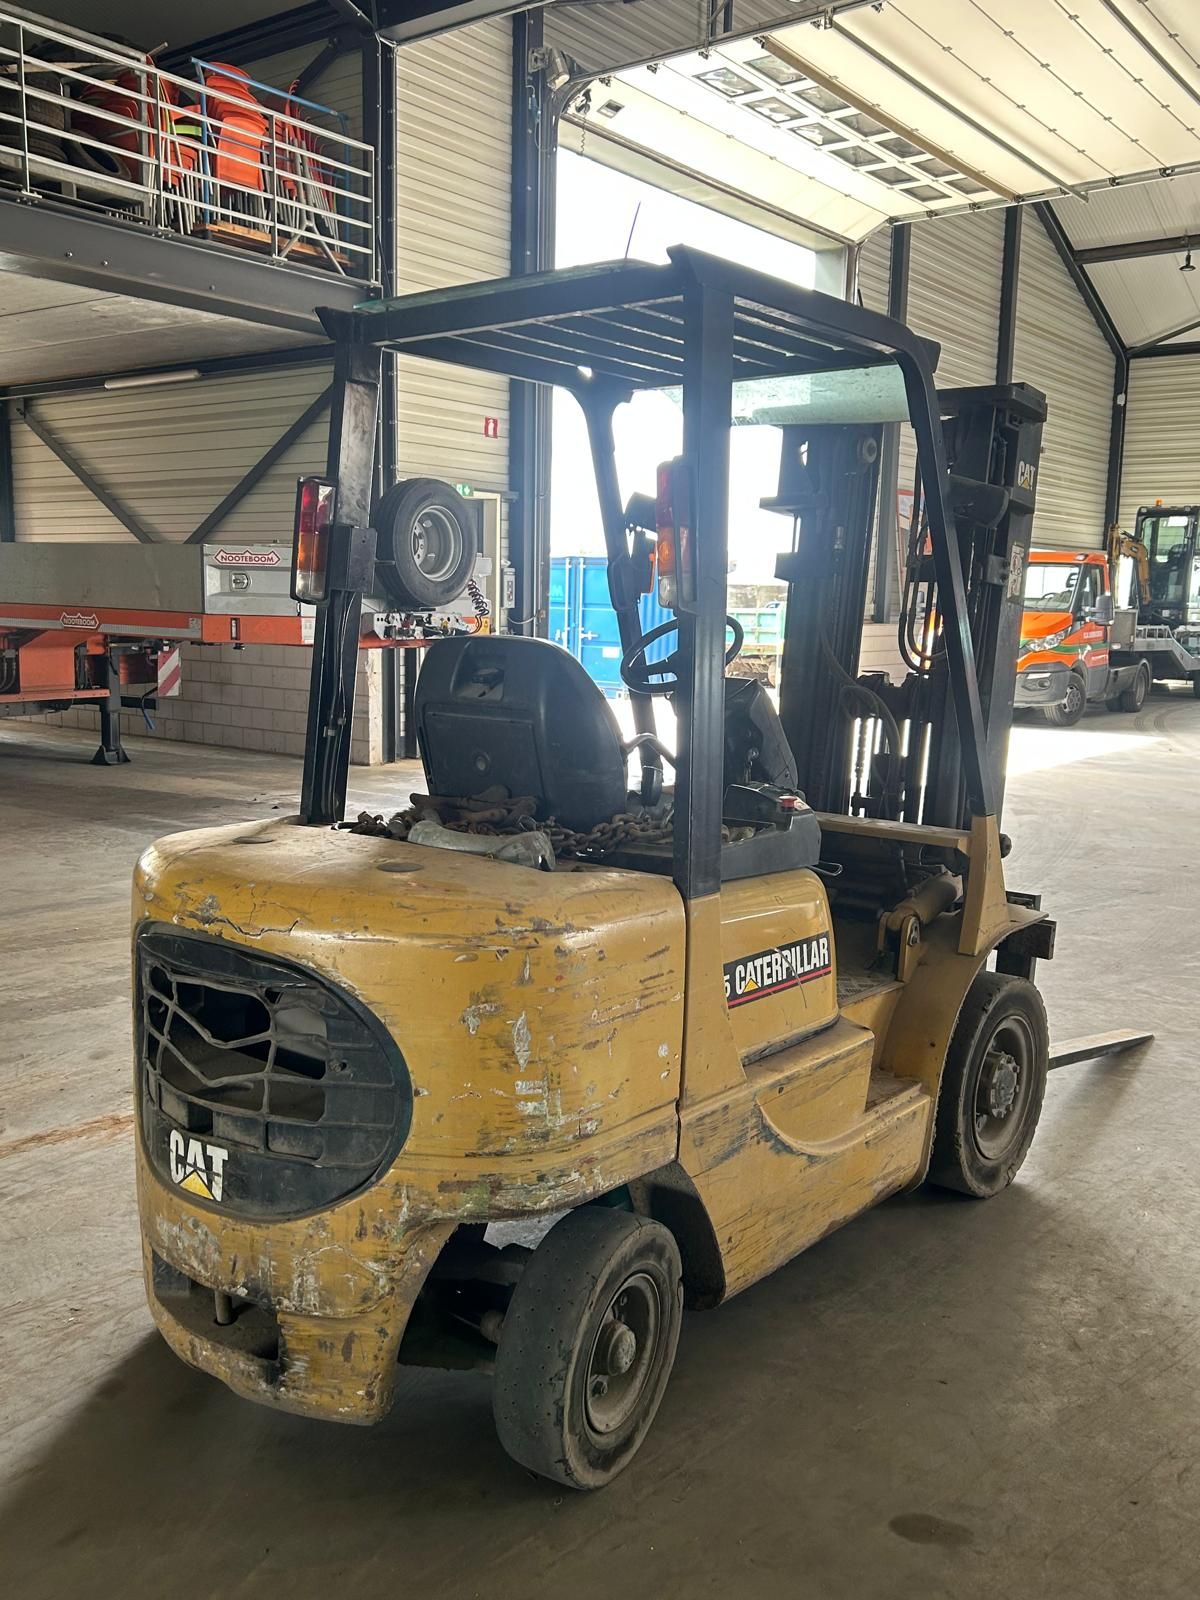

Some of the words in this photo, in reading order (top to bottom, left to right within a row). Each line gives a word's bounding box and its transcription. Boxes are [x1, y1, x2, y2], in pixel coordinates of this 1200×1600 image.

[1017, 460, 1036, 491] CAT
[220, 555, 275, 563] NOOTEBOOM
[735, 937, 829, 995] CATERPILLAR
[169, 1129, 229, 1202] CAT
